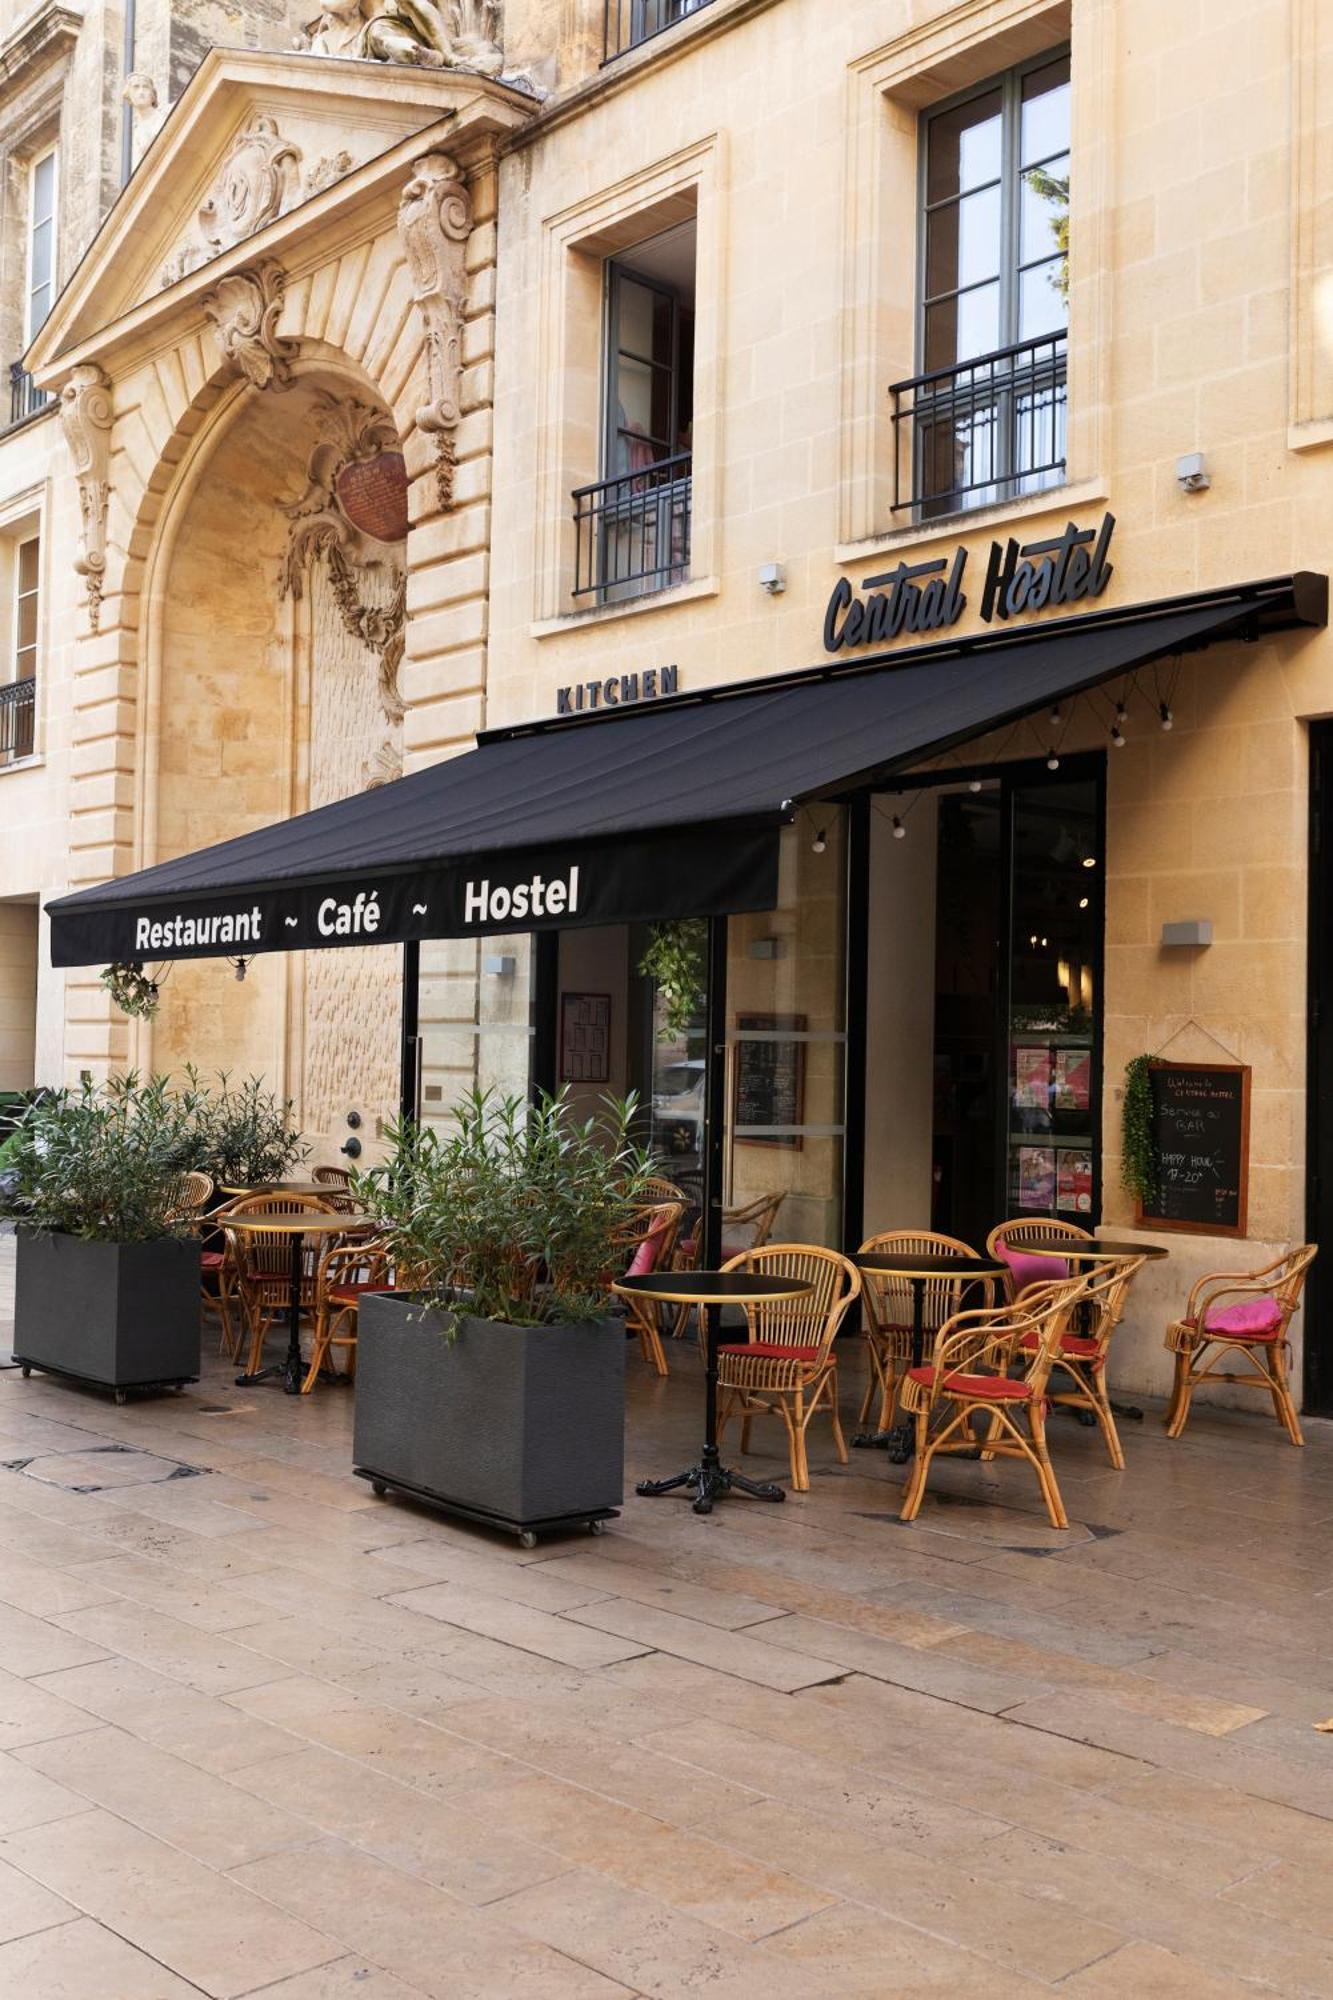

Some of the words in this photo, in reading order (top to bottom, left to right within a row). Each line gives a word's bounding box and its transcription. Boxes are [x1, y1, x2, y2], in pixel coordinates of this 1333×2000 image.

[823, 545, 969, 653] Central
[979, 511, 1117, 623] Hostel
[557, 664, 678, 714] KITCHEN
[135, 906, 262, 950] Restaurant
[317, 890, 381, 936] Café
[464, 866, 580, 923] Hostel
[1161, 1152, 1186, 1166] HAPPY
